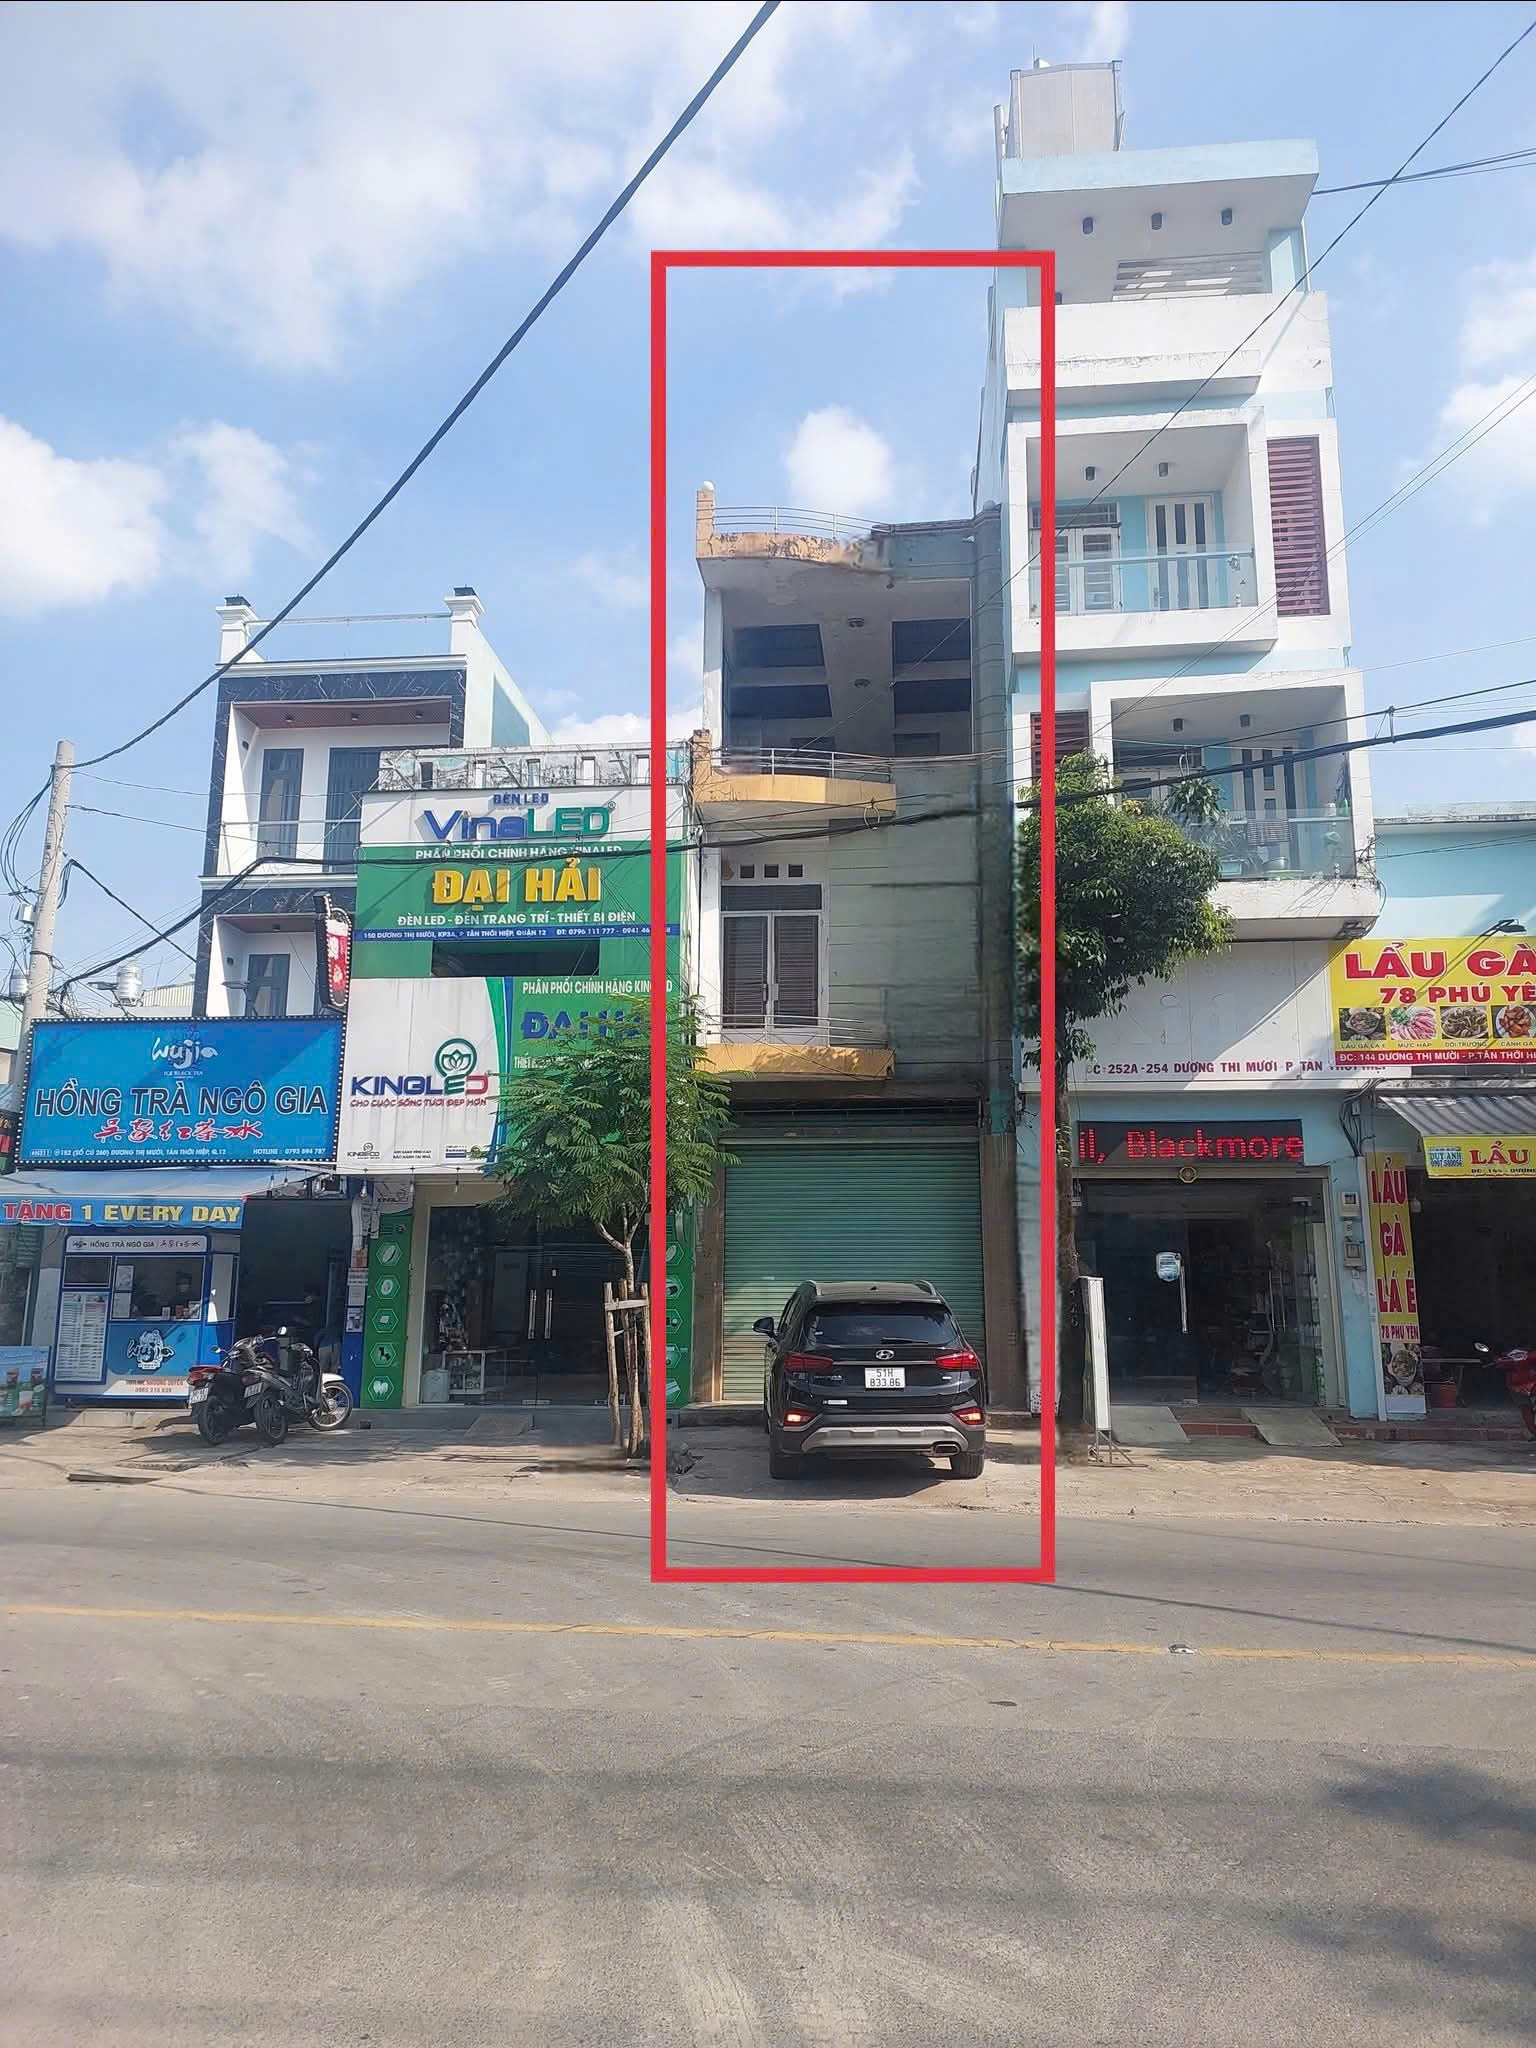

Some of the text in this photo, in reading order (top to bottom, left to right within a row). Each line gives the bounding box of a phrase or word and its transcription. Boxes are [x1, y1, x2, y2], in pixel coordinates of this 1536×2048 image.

[524, 793, 549, 804] LED
[424, 807, 610, 840] VinaLED
[487, 846, 527, 859] CHÍNH
[432, 857, 601, 911] ĐẠI HẢI
[397, 912, 422, 926] ĐÈN
[425, 915, 446, 925] LED
[454, 911, 480, 926] ĐÈN
[483, 914, 527, 925] TRANG
[531, 910, 550, 923] TRÍ
[558, 909, 589, 923] THIẾT
[593, 912, 605, 925] BỊ
[608, 911, 636, 925] ĐIỆN
[1344, 942, 1536, 980] LẨU GÀ
[522, 979, 549, 995] PHÂN
[551, 977, 573, 994] PHỐI
[574, 977, 603, 994] CHÍNH
[1380, 987, 1418, 1004] 78
[1428, 982, 1492, 1003] PHÚ
[1174, 1061, 1215, 1073] DƯƠNG
[1340, 1053, 1357, 1062] ĐC:
[1359, 1053, 1376, 1061] 144
[1378, 1052, 1413, 1061] DƯƠNG
[1416, 1052, 1432, 1062] THỊ
[1435, 1050, 1460, 1060] MƯỜI
[351, 1074, 489, 1096] KINGLED
[35, 1078, 329, 1117] HỒNG TRÀ NGÔ GIA
[350, 1099, 370, 1108] CHO
[398, 1096, 423, 1108] SỐNG
[1127, 1128, 1304, 1159] Blackmore
[1469, 1140, 1529, 1165] LẨU
[1371, 1157, 1408, 1205] LẨU
[3, 1199, 241, 1224] TẶNG 1 EVERY DAY
[111, 1239, 125, 1248] TRÀ
[126, 1239, 143, 1248] NGÔ
[144, 1239, 155, 1248] GIA
[1380, 1214, 1407, 1257] GÀ
[1377, 1270, 1417, 1313] LÁ É
[876, 1368, 894, 1378] 51H
